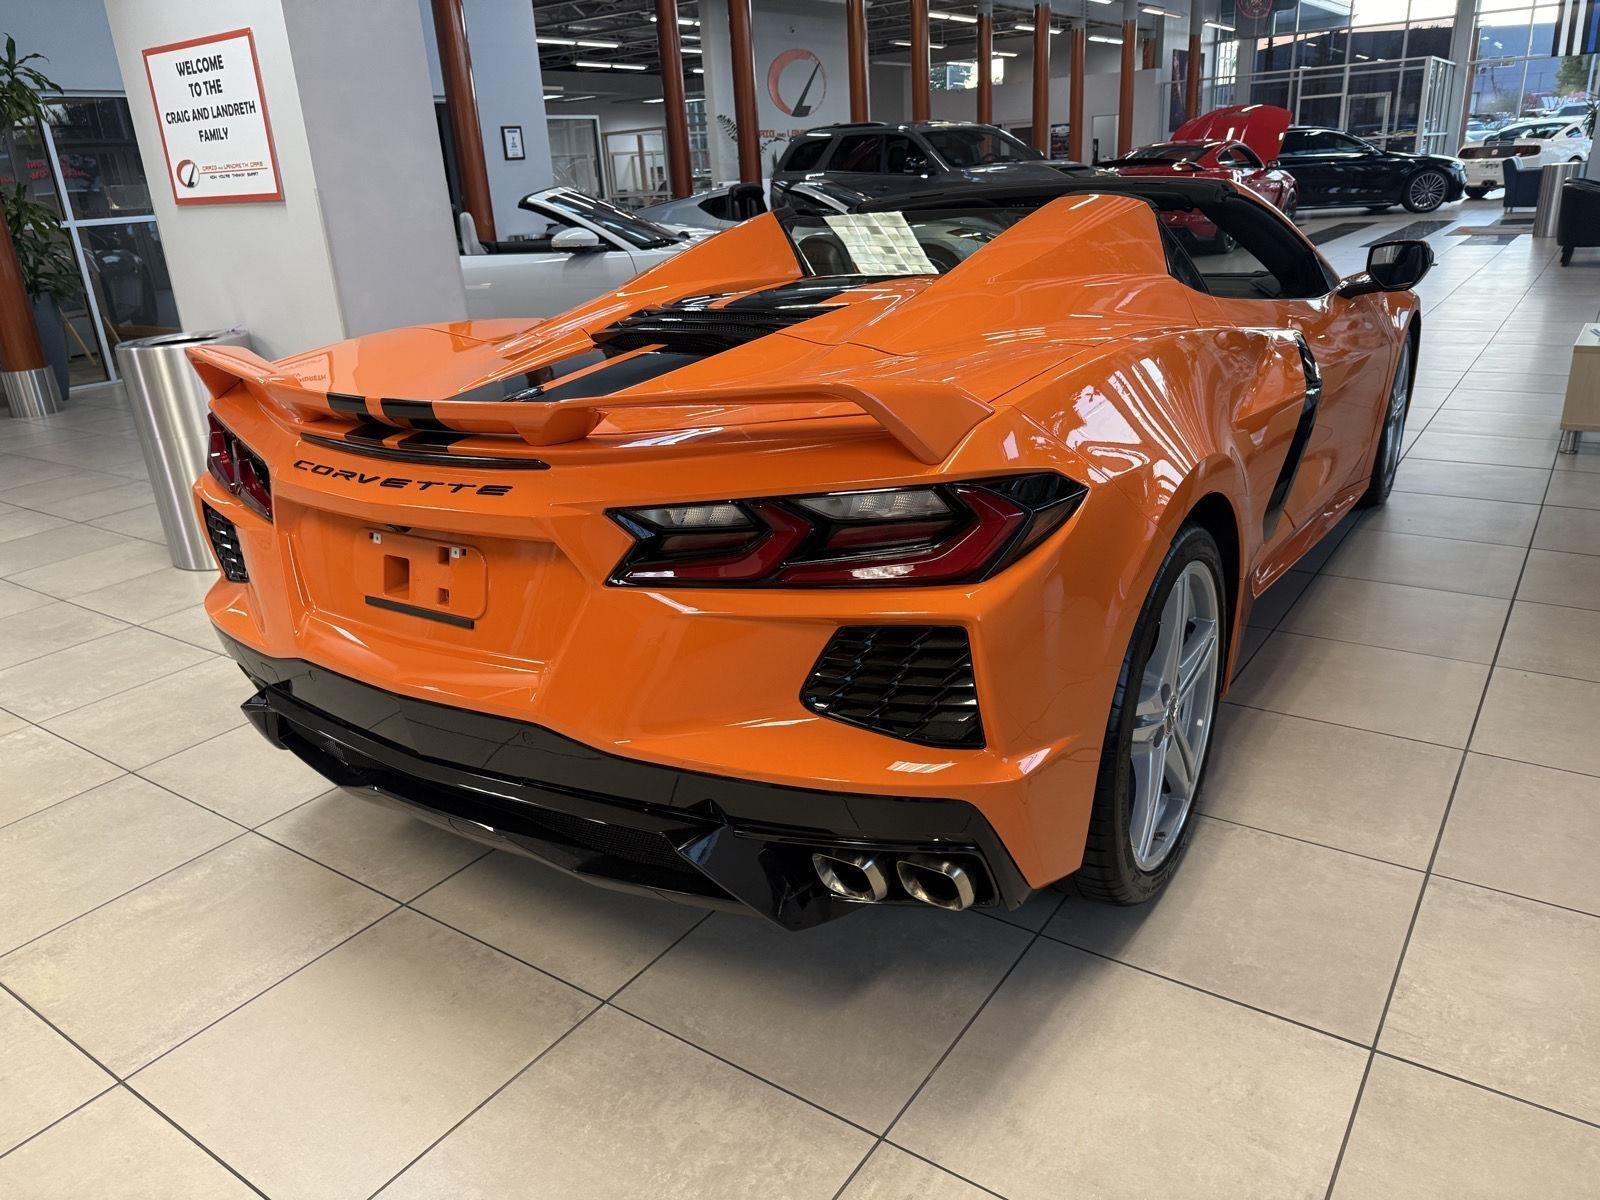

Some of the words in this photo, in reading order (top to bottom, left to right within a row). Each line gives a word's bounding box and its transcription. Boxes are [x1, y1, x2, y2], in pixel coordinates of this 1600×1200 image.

[176, 55, 224, 77] WELCOME
[188, 82, 202, 98] TO
[203, 79, 223, 95] THE
[165, 110, 190, 125] CRAIG
[192, 107, 210, 122] AND
[211, 100, 256, 119] LANDRETH
[198, 127, 229, 142] FAMILY
[293, 459, 514, 497] CORVETTE
